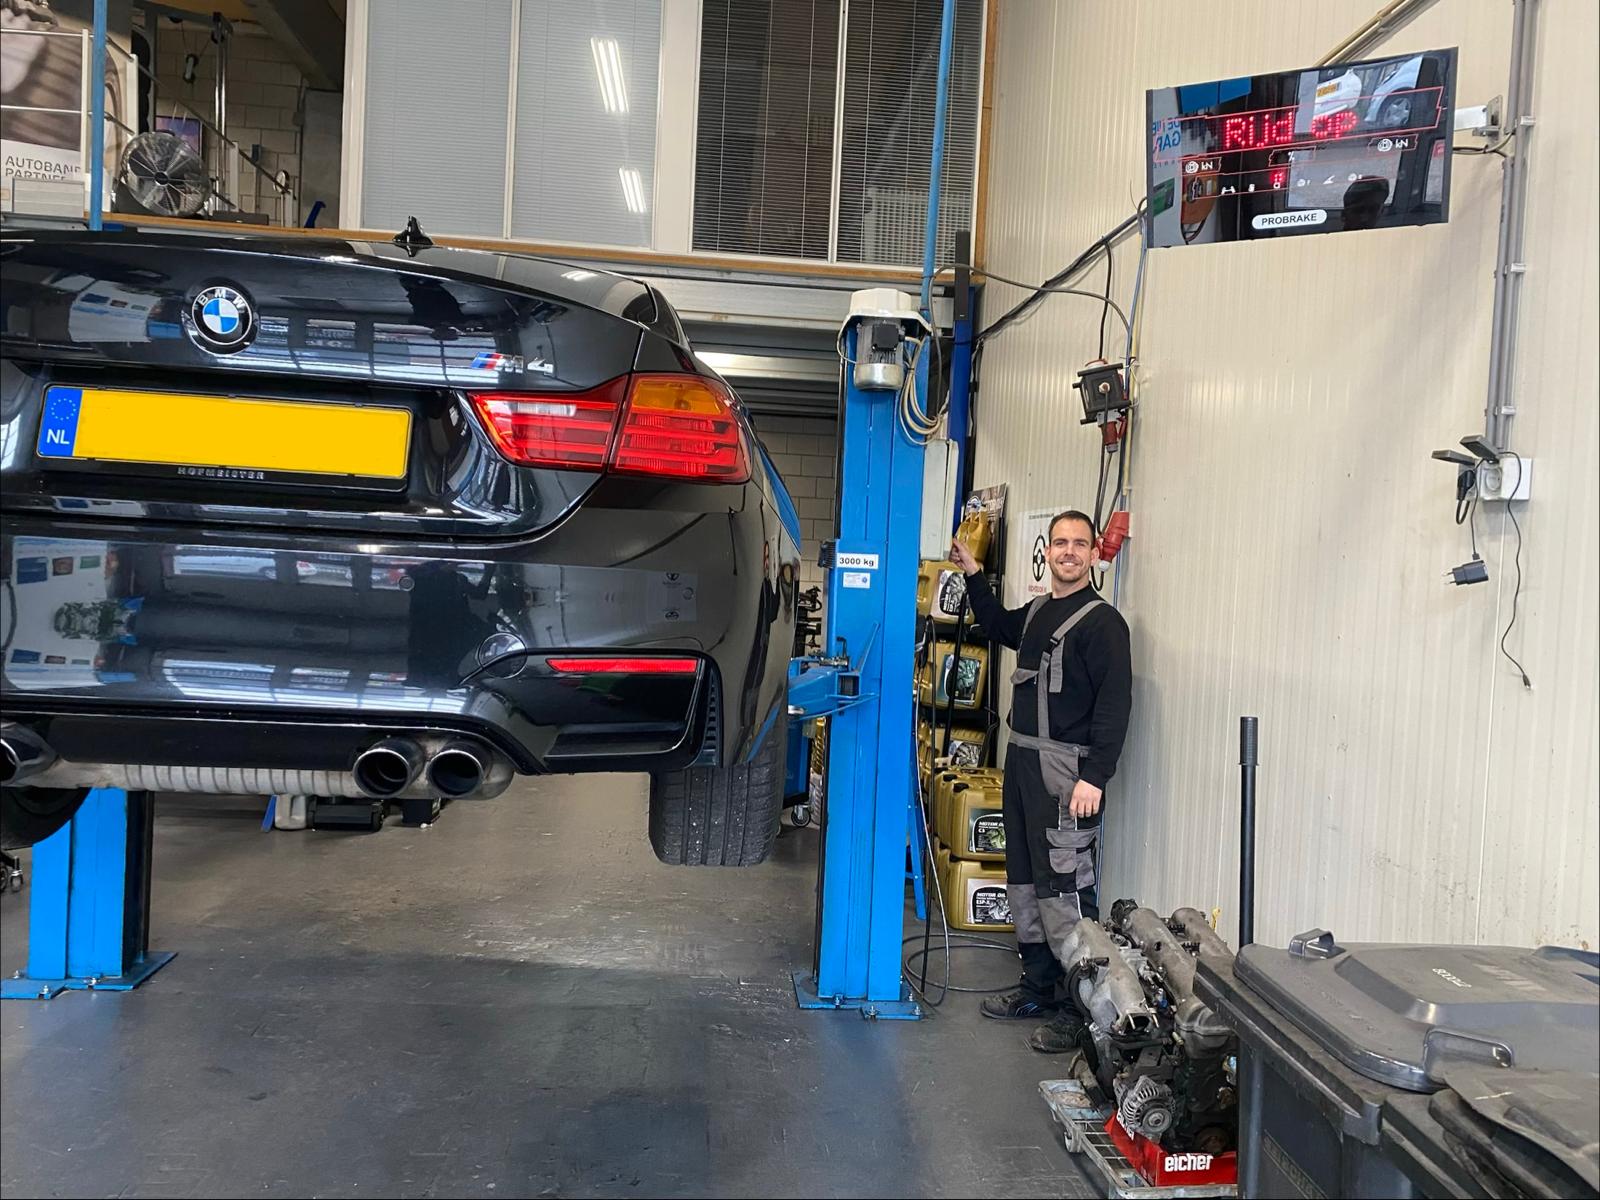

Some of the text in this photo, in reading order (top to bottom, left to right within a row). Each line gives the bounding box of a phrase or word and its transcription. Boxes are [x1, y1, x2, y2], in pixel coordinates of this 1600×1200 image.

[1261, 212, 1318, 226] PROBRAKE
[197, 288, 246, 313] BMW
[46, 428, 70, 445] NL
[177, 466, 265, 480] HOFMEISTER
[839, 557, 874, 567] 3000 kg
[1164, 1153, 1214, 1172] eicher
